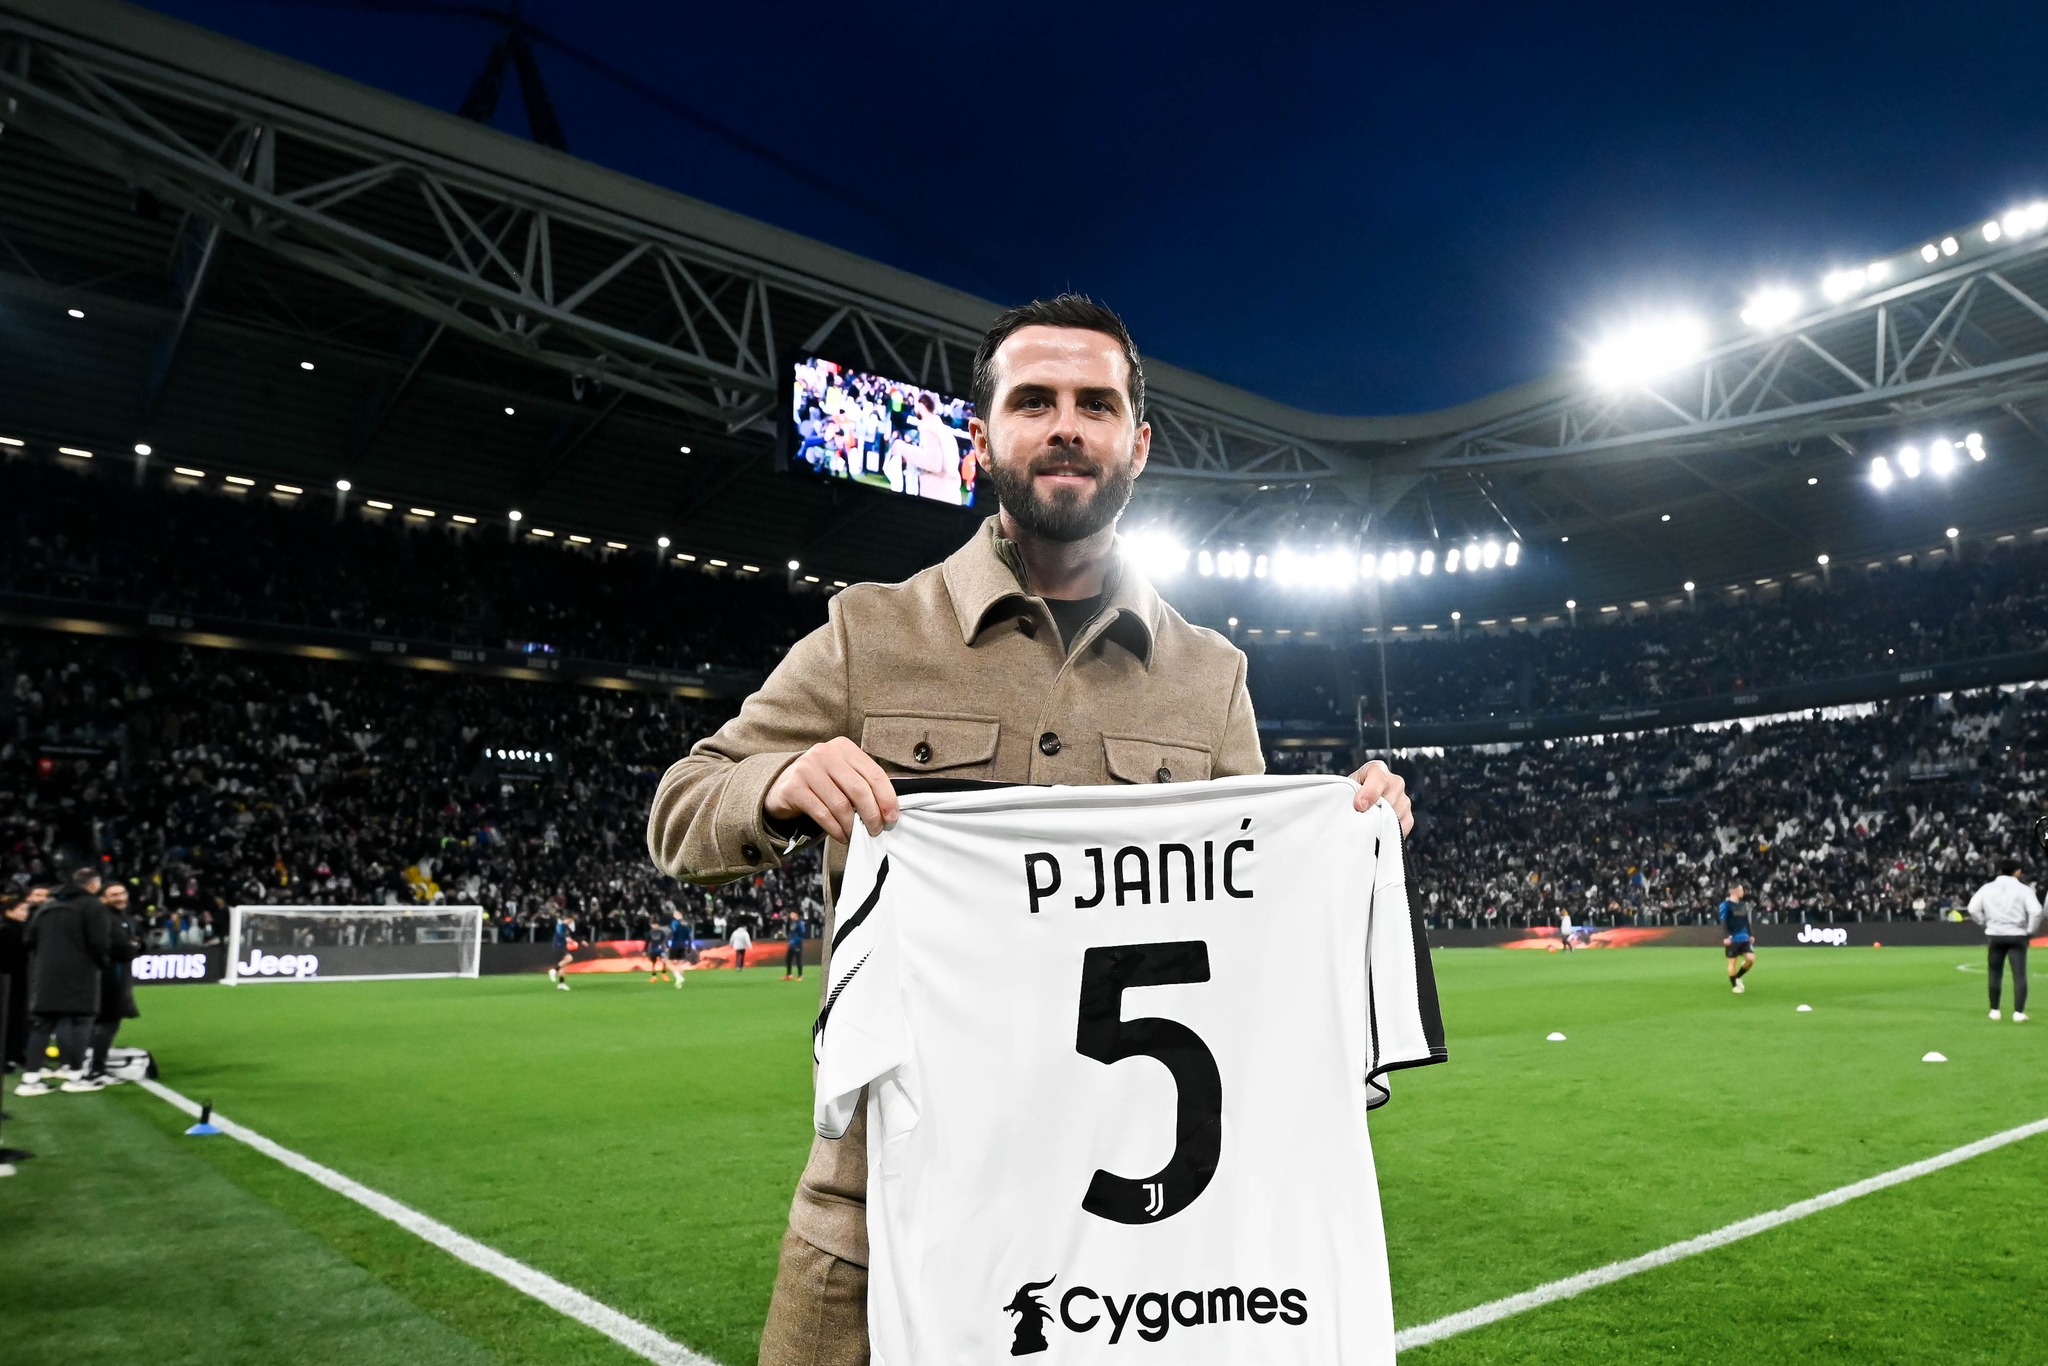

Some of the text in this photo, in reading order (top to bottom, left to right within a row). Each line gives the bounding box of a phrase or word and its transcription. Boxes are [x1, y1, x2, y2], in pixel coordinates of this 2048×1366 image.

[1024, 818, 1254, 914] PJANIĆ
[1797, 924, 1848, 946] Jeep
[131, 953, 207, 980] ENTUS
[237, 949, 319, 978] Jeep
[1076, 940, 1223, 1225] 5
[1059, 1285, 1308, 1345] Cygames
